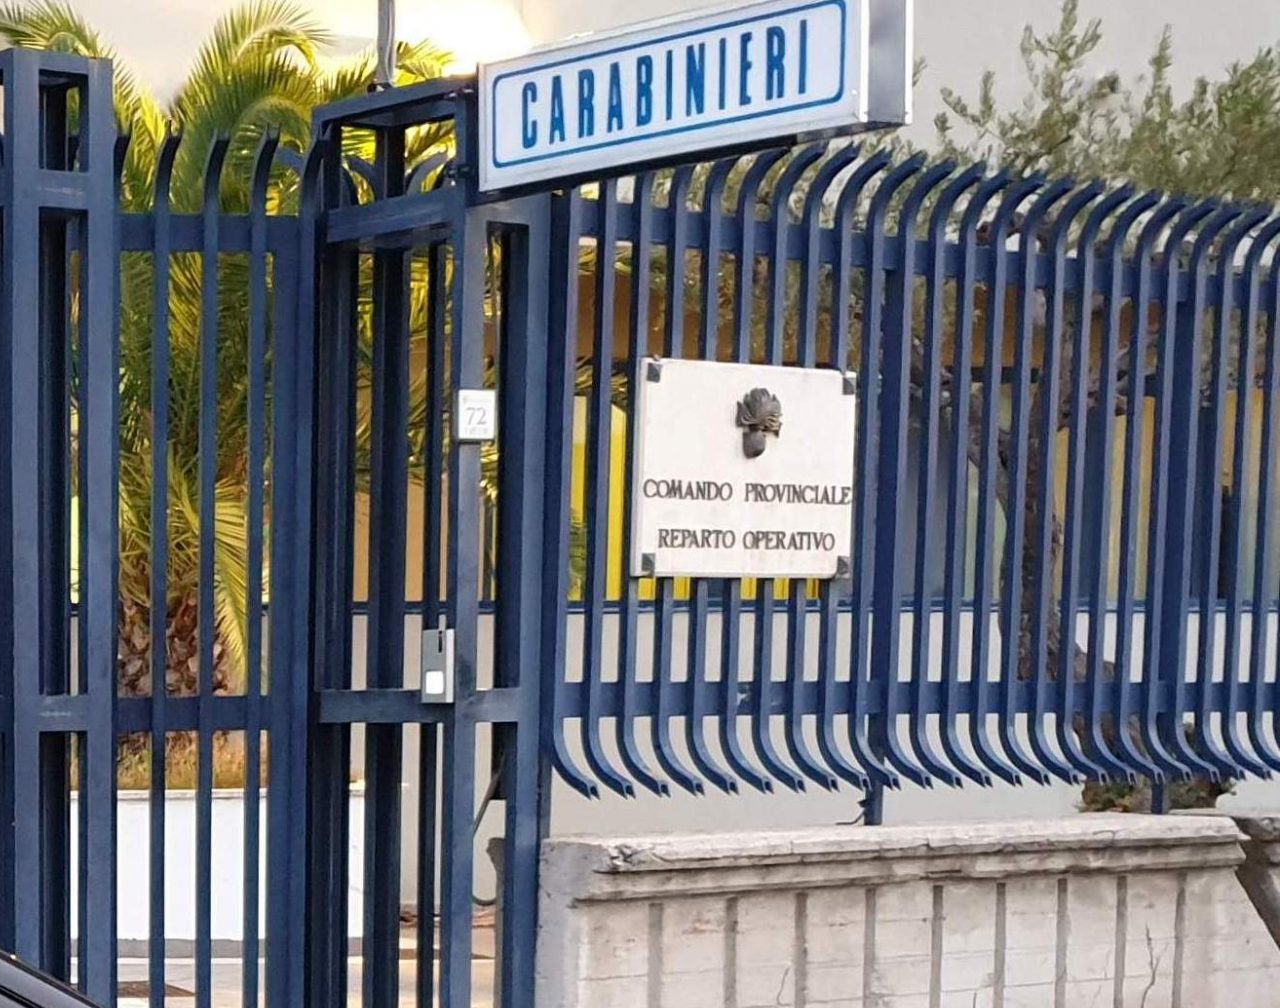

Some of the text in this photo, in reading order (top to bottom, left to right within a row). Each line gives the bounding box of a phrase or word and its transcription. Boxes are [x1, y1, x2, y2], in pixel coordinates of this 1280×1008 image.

[522, 19, 807, 149] CARABINIERI
[465, 406, 488, 426] 72
[643, 479, 851, 505] COMANDO PROVINCIALE
[658, 528, 835, 550] REPARTO OPERATIVO
